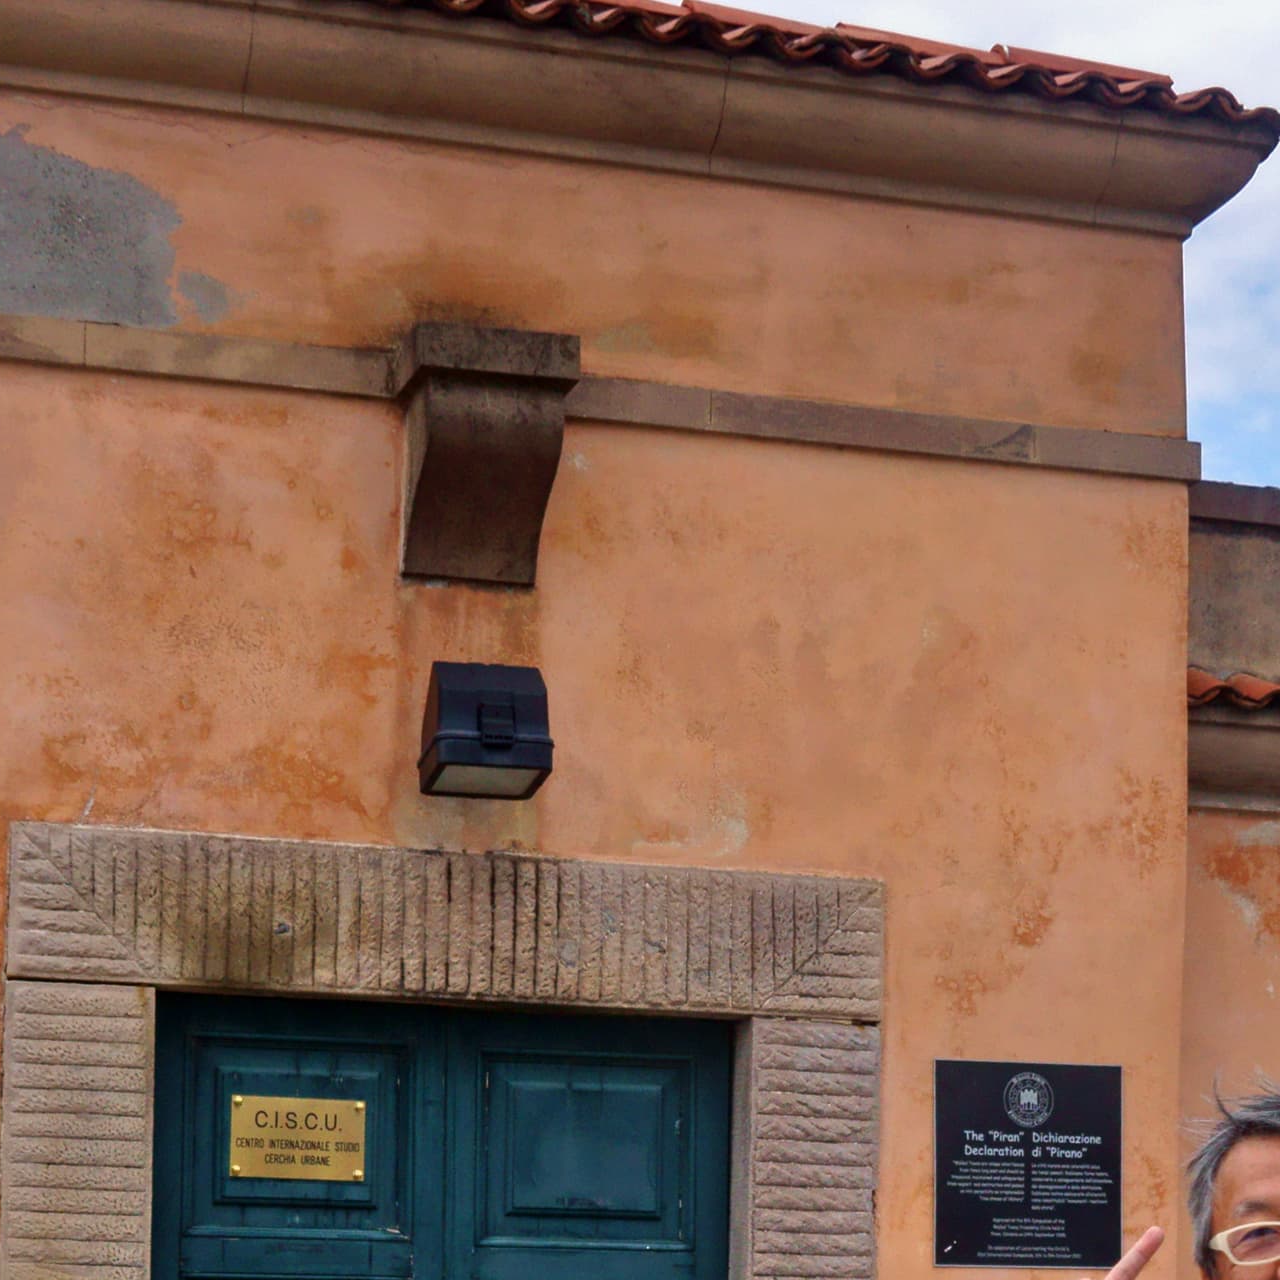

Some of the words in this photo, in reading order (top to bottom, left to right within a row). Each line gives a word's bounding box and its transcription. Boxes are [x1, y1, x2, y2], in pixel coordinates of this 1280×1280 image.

[254, 1110, 343, 1132] C.I.S.C.U.
[963, 1130, 985, 1141] The
[988, 1129, 1025, 1143] "Piran"
[1032, 1132, 1102, 1145] Dichiarazione
[235, 1137, 266, 1149] CENTRO
[269, 1139, 331, 1152] INTERNAZIONALE
[334, 1141, 361, 1153] STUDIO
[964, 1144, 1025, 1157] Declaration
[1032, 1146, 1042, 1158] di
[1046, 1146, 1088, 1159] "Pirano"
[264, 1153, 297, 1165] CERCHIA
[300, 1155, 331, 1166] URBANE
